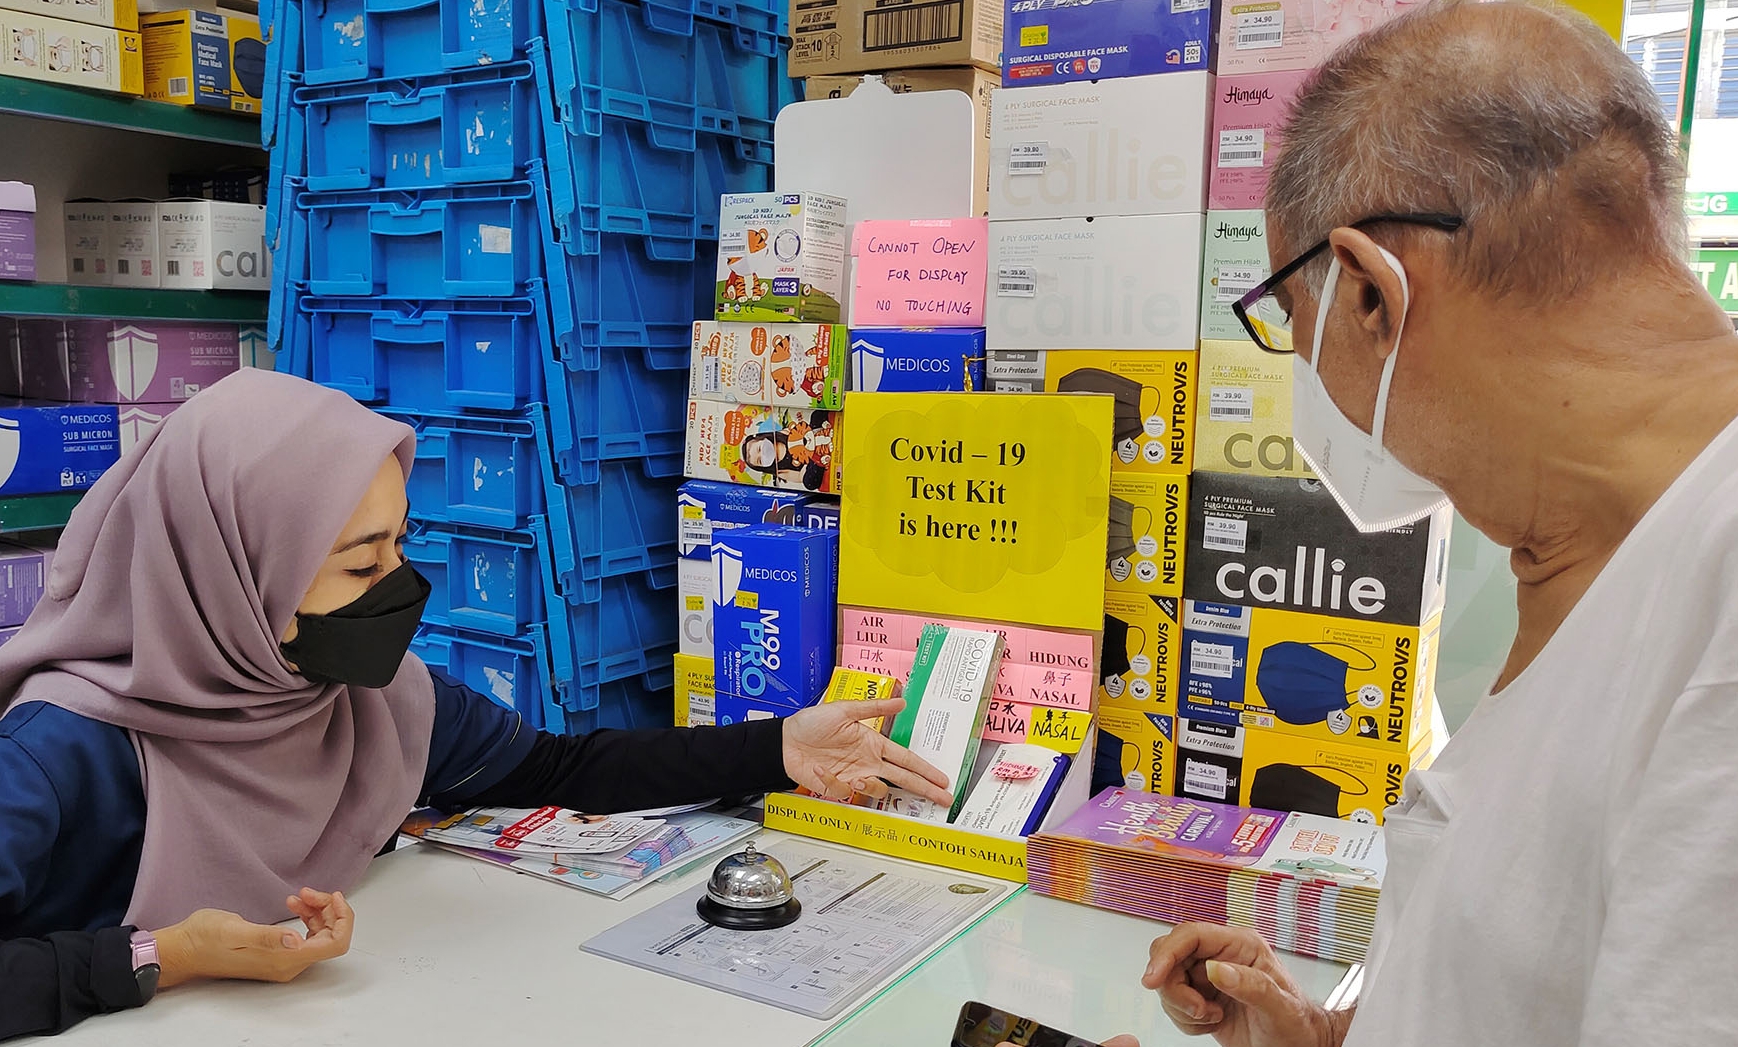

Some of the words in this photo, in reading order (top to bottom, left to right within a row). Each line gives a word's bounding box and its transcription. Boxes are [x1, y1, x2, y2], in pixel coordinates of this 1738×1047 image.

[811, 39, 822, 52] 10
[1009, 55, 1043, 64] SURGICAL
[1043, 49, 1086, 60] DISPOSABLE
[1087, 48, 1105, 56] FACE
[1107, 46, 1129, 54] MASK
[1010, 102, 1021, 110] PLY
[1023, 99, 1058, 109] SURGICAL
[1058, 98, 1076, 106] FACE
[1078, 96, 1100, 104] MASK
[1223, 85, 1275, 106] Himaya
[1003, 128, 1188, 206] callie
[784, 195, 799, 204] PCS
[1018, 233, 1053, 242] SURGICAL
[1054, 233, 1072, 241] FACE
[1074, 232, 1094, 240] MASK
[1214, 222, 1263, 242] Himaya
[867, 236, 920, 255] CANNOT
[932, 236, 976, 255] OPEN
[887, 269, 910, 282] FOR
[919, 269, 969, 285] DISPLAY
[789, 281, 797, 293] 3
[876, 300, 891, 311] NO
[905, 299, 972, 316] TOUCHING
[190, 347, 204, 355] SUB
[206, 346, 235, 355] MICRON
[885, 356, 950, 373] MEDICOS
[993, 366, 1007, 374] Extra
[1008, 366, 1038, 374] Protection
[69, 414, 112, 424] MEDICOS
[689, 420, 694, 429] 20
[62, 431, 79, 440] SUB
[81, 430, 113, 440] MICRON
[890, 437, 963, 464] Covid
[998, 442, 1026, 467] 19
[1125, 441, 1132, 450] 4
[1223, 432, 1311, 473] ca
[75, 475, 86, 484] 0.1
[906, 475, 957, 502] Test
[966, 479, 1007, 505] Kit
[725, 503, 751, 512] MEDICOS
[1204, 501, 1236, 511] SURGICAL
[1237, 504, 1253, 512] FACE
[1255, 506, 1275, 514] MASK
[1222, 496, 1253, 504] PREMIUM
[899, 512, 917, 536] is
[926, 514, 980, 541] here
[989, 518, 1018, 544] !!!
[1118, 560, 1125, 568] 4
[744, 567, 798, 583] MEDICOS
[1215, 545, 1386, 615] callie
[1158, 599, 1174, 617] Packaging
[1219, 606, 1230, 614] Blue
[860, 615, 885, 628] AIR
[1191, 617, 1207, 626] Extra
[1208, 619, 1242, 631] Protection
[759, 609, 781, 671] M99
[856, 630, 889, 645] LIUR
[860, 648, 884, 663] 口水
[963, 637, 975, 660] RAPID
[1205, 647, 1222, 655] 34.90
[741, 620, 767, 697] PRO
[1029, 651, 1089, 669] HIDUNG
[956, 656, 970, 687] ANTIGEN
[958, 638, 987, 703] COVID-19
[1042, 670, 1073, 687] 鼻子
[687, 680, 702, 688] FACE
[1112, 677, 1119, 686] 4
[951, 684, 962, 700] TEST
[1029, 687, 1081, 706] NASAL
[1336, 712, 1343, 721] 4
[1032, 721, 1081, 741] NASAL
[1152, 716, 1169, 735] Packaging
[1196, 724, 1215, 732] Premium
[1185, 735, 1201, 745] Extra
[1202, 738, 1236, 751] Protection
[1199, 767, 1216, 776] 34.90
[767, 803, 817, 824] DISPLAY
[818, 815, 853, 831] ONLY
[861, 822, 898, 842] 展示品
[908, 835, 967, 856] CONTOH
[969, 847, 1025, 868] SAHAJA
